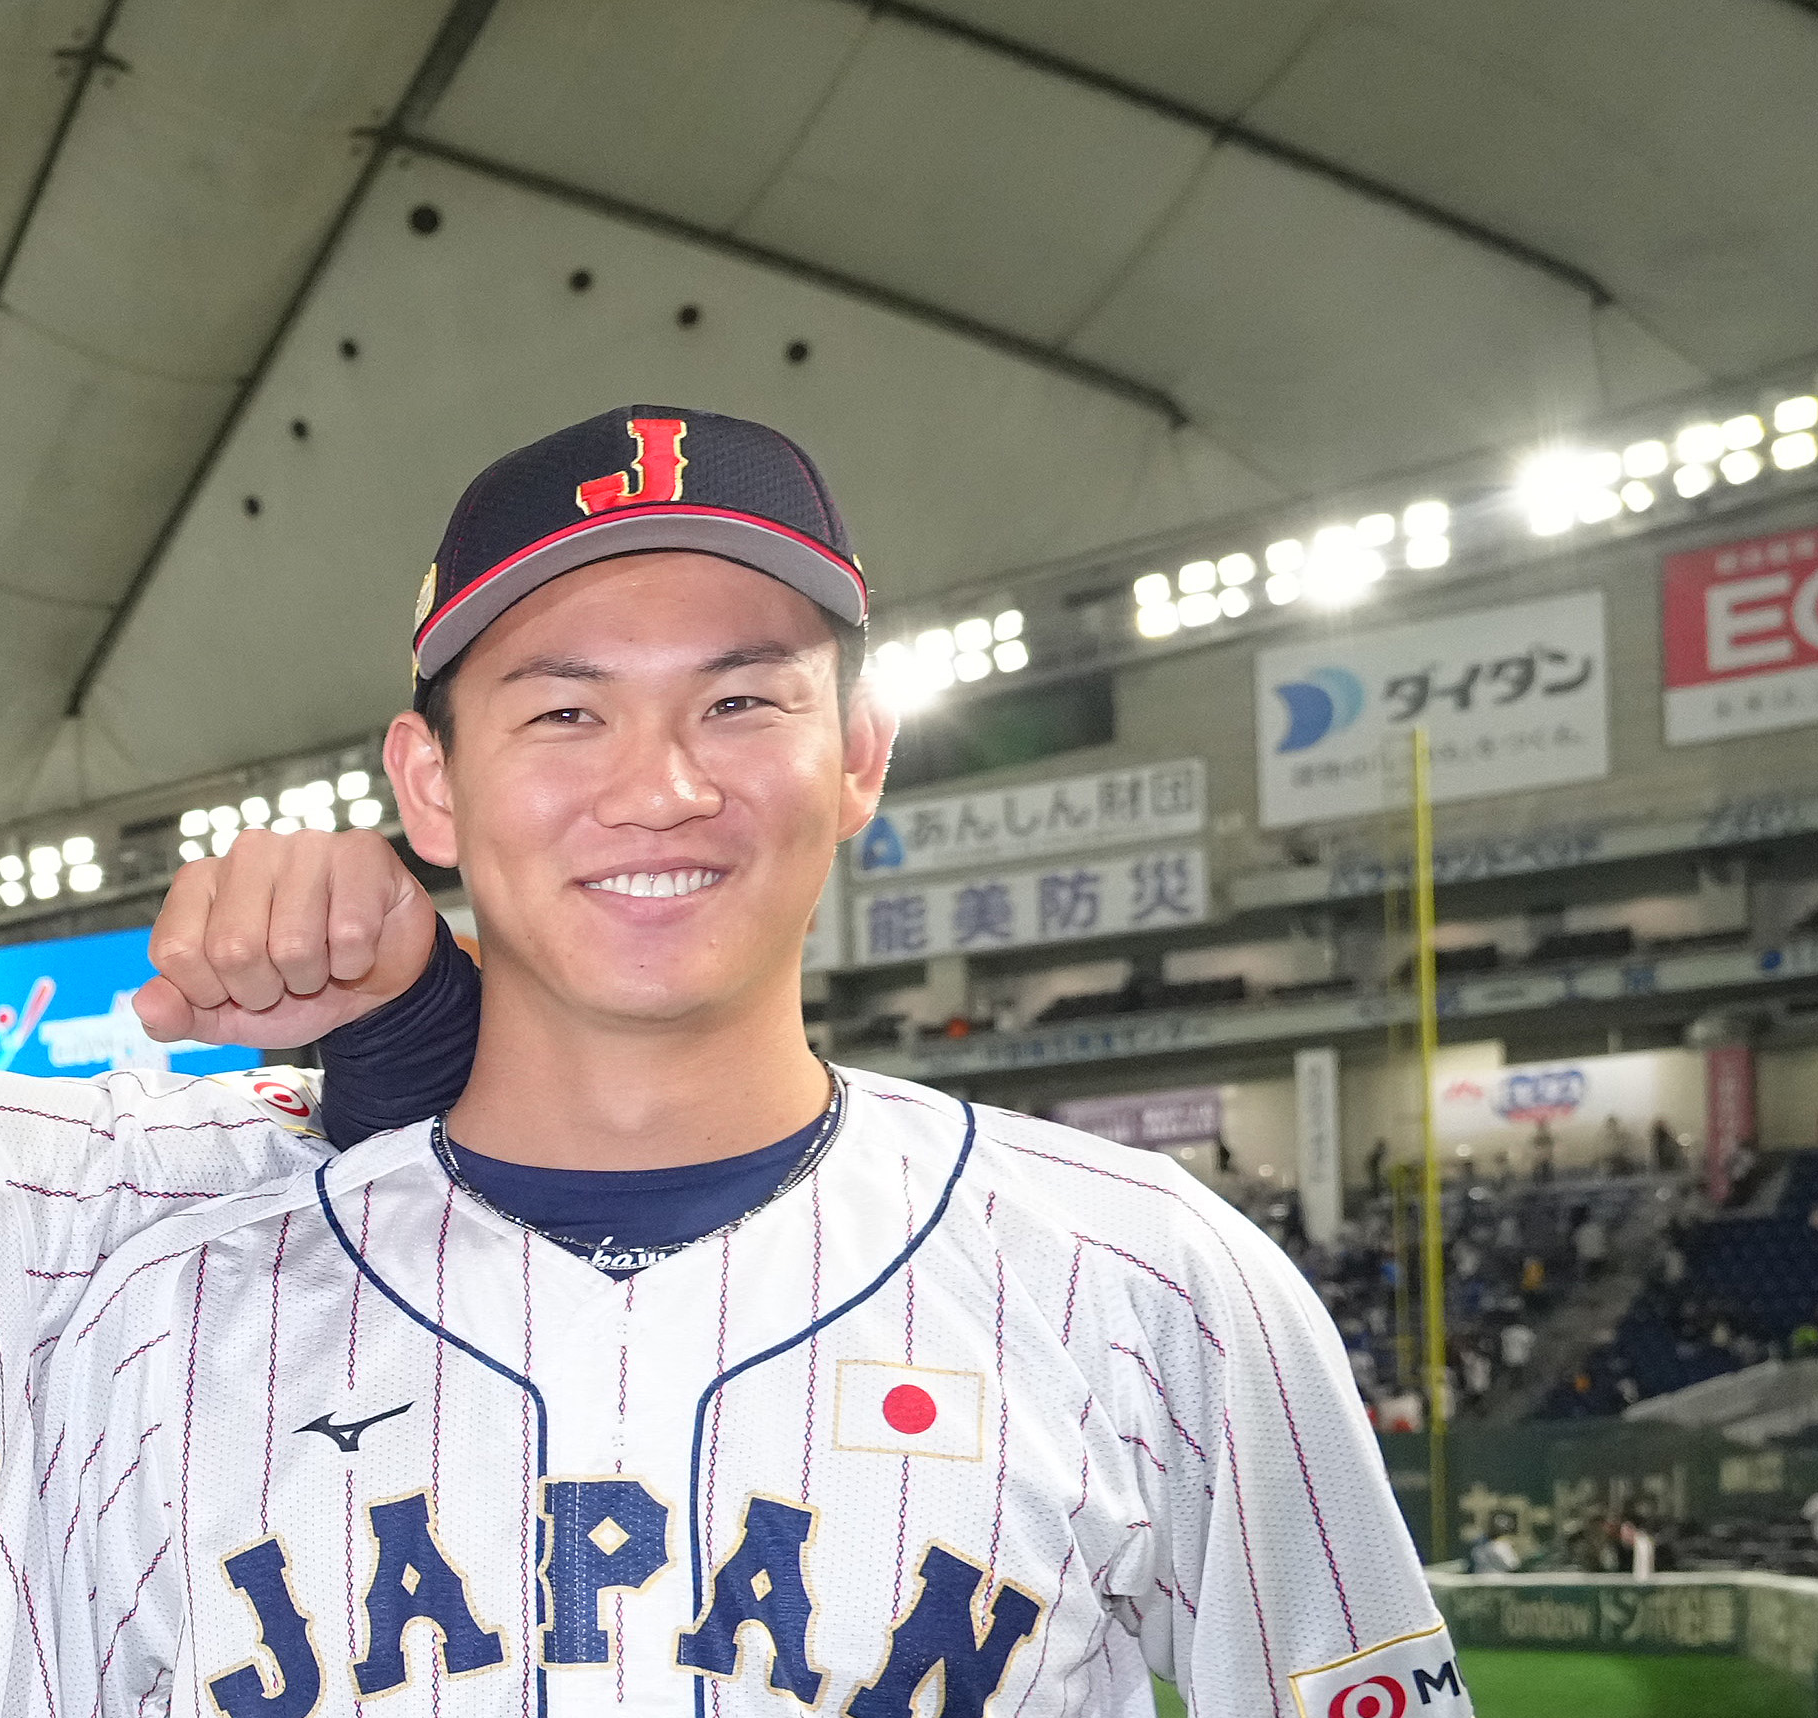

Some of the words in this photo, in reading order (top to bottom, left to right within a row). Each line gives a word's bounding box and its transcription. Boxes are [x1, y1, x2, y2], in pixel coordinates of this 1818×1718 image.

[575, 417, 689, 517] J
[1383, 644, 1594, 723] ダイダン
[908, 766, 1198, 850] あんしん財団
[868, 856, 1193, 955] 能美防災
